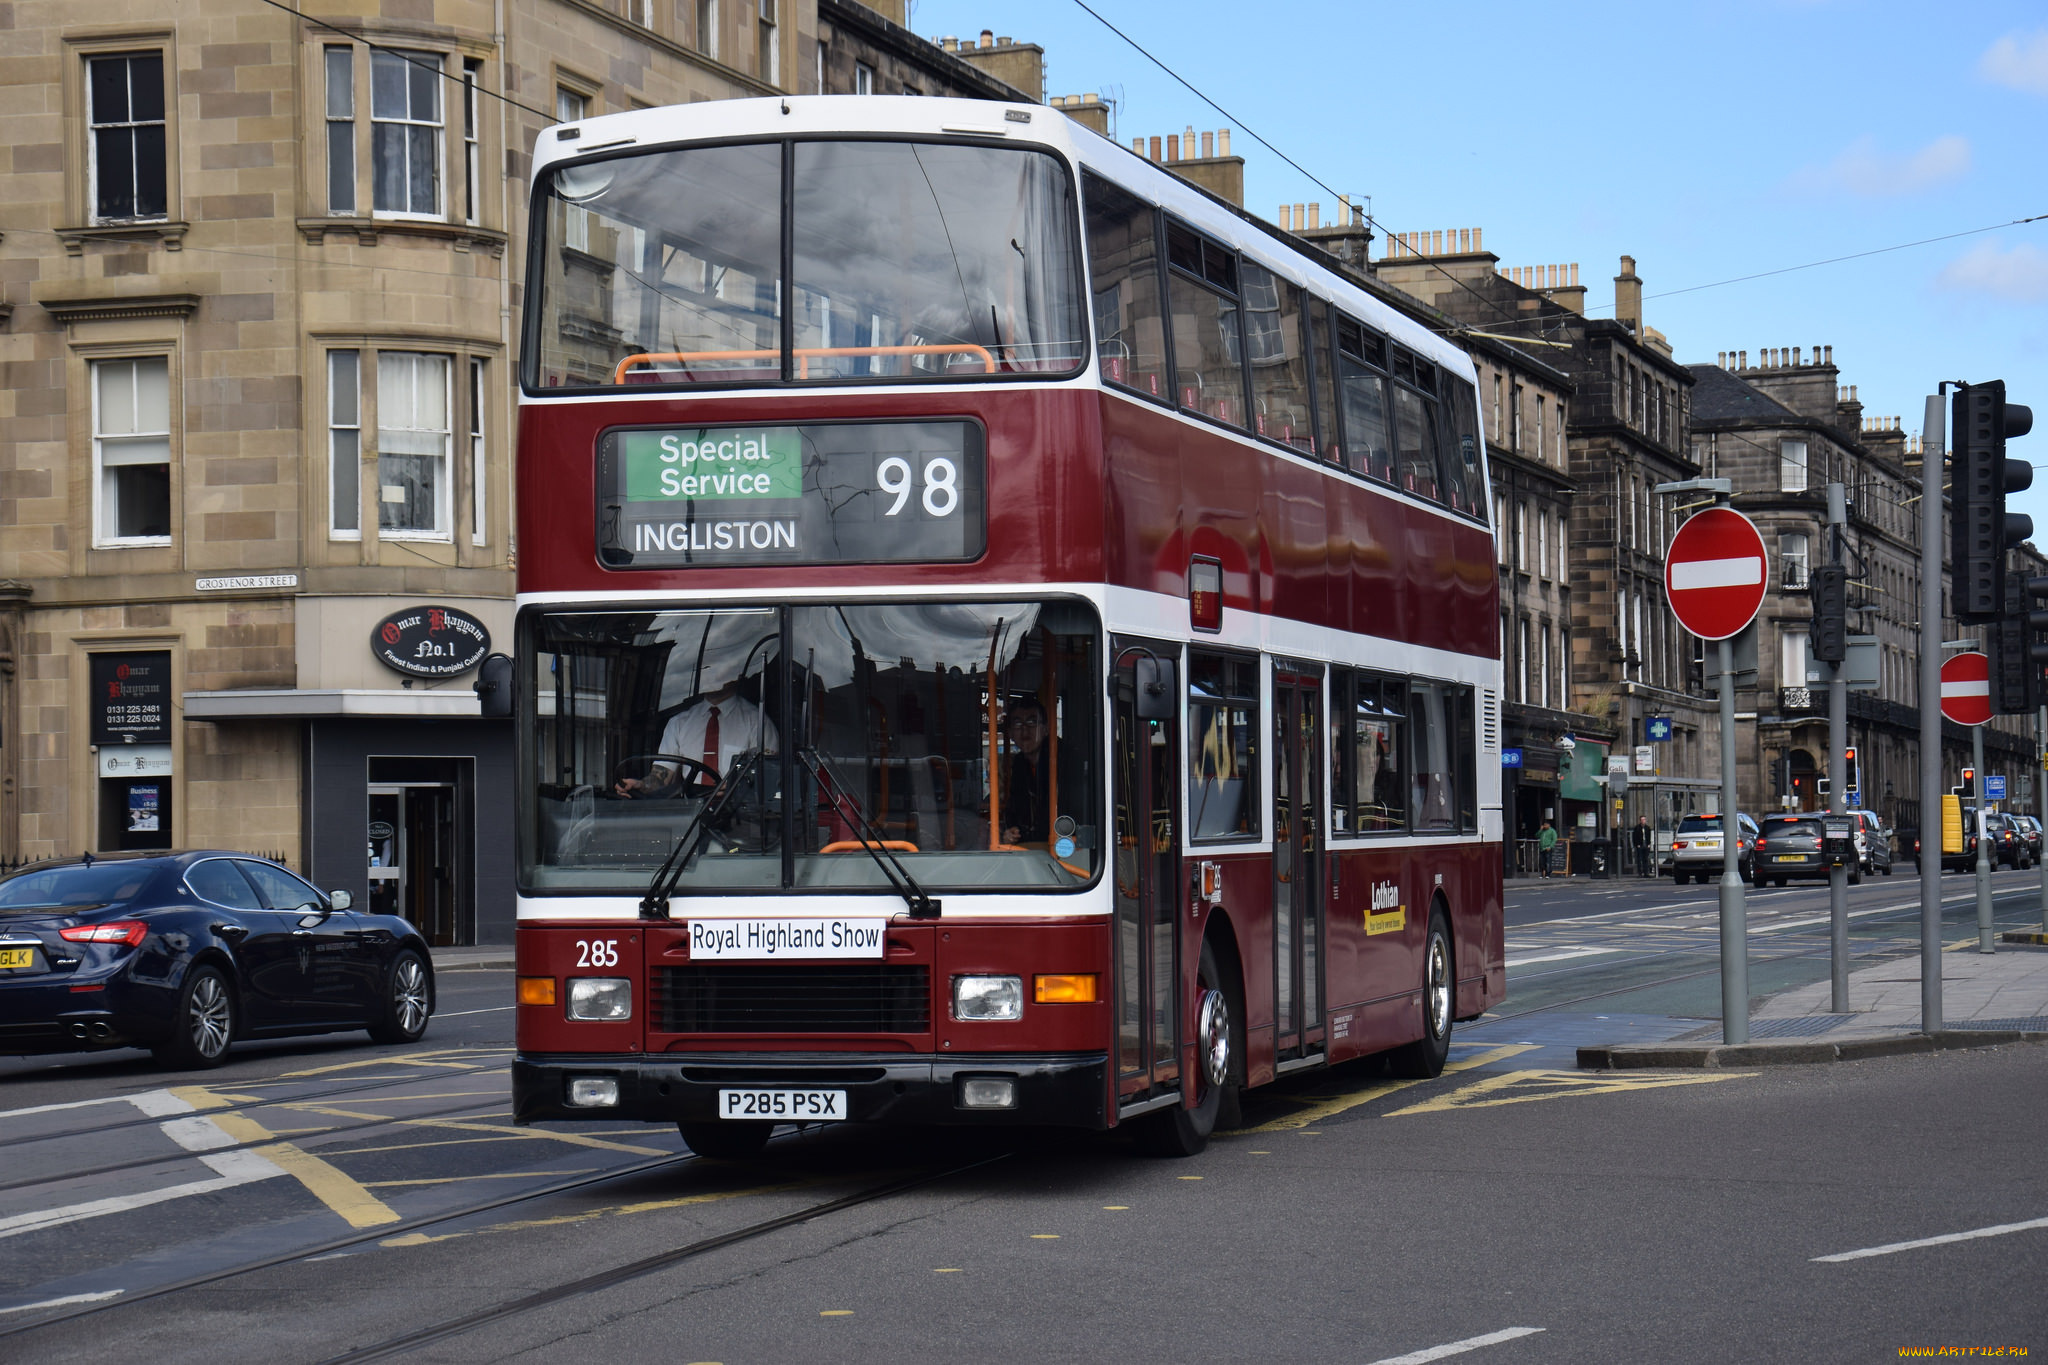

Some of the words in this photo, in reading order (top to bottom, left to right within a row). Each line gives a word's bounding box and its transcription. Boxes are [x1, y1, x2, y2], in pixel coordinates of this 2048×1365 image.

[659, 433, 770, 467] Special
[660, 467, 771, 496] Service
[876, 457, 958, 517] 98
[635, 521, 796, 551] INGLISTON
[198, 577, 255, 589] GROSVENOR
[259, 576, 294, 586] STREET
[382, 616, 421, 644] Omar
[428, 609, 485, 641] Khayyam
[384, 650, 406, 667] Finest
[406, 662, 429, 673] Indian
[438, 662, 465, 673] Punjabi
[464, 646, 486, 666] Cuisine
[414, 640, 455, 658] No.1
[116, 664, 150, 680] Omar
[106, 705, 125, 714] 0131
[126, 705, 141, 713] 225
[142, 704, 160, 713] 2481
[106, 715, 125, 724] 0131
[126, 715, 141, 723] 225
[142, 714, 161, 723] 0024
[130, 787, 157, 795] Business
[1371, 880, 1399, 910] Lothian
[693, 923, 741, 954] Royal
[747, 922, 825, 954] Highland
[831, 921, 880, 948] Show
[1, 951, 26, 965] GLK
[576, 940, 619, 968] 285
[728, 1093, 786, 1115] P285
[793, 1093, 836, 1114] PSX
